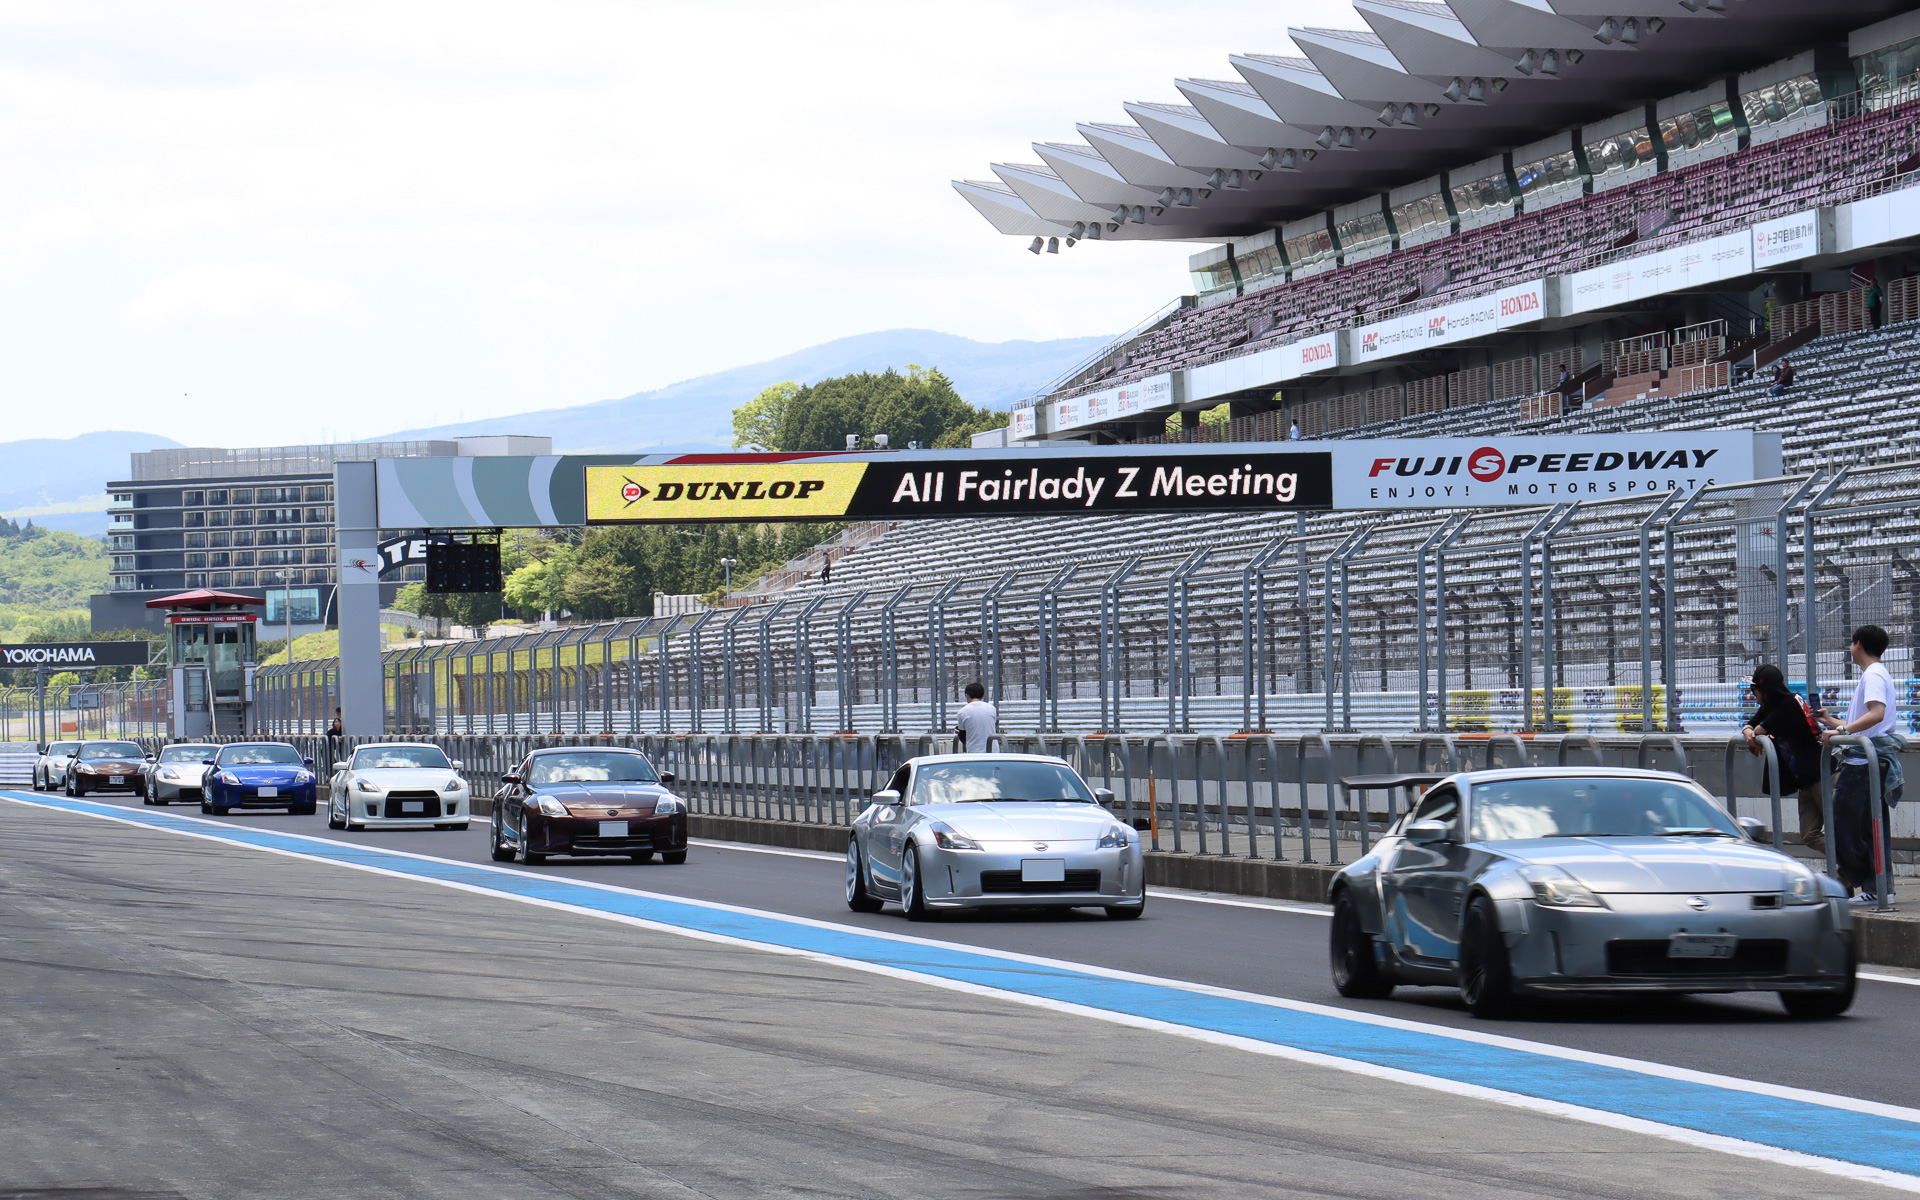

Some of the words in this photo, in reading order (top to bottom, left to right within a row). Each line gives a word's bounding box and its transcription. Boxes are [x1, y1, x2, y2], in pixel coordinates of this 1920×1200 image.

[1767, 223, 1814, 246] トヨタ自動車九州
[1711, 246, 1745, 262] PORSCHE
[1642, 264, 1672, 279] PORSCHE
[1501, 291, 1540, 317] HONDA
[1447, 316, 1469, 330] Honda
[1470, 309, 1495, 326] RACING
[1380, 332, 1401, 345] Honda
[1401, 326, 1423, 340] RACING
[1302, 342, 1333, 364] HONDA
[1368, 455, 1463, 478] FUJI
[1468, 447, 1719, 482] SPEEDWAY
[653, 480, 825, 501] DUNLOP
[892, 472, 943, 503] All
[957, 467, 1105, 508] Fairlady
[1115, 467, 1141, 498] Z
[1150, 464, 1299, 502] Meeting
[1370, 484, 1471, 499] ENJOY!
[3, 647, 96, 664] YOKOHAMA
